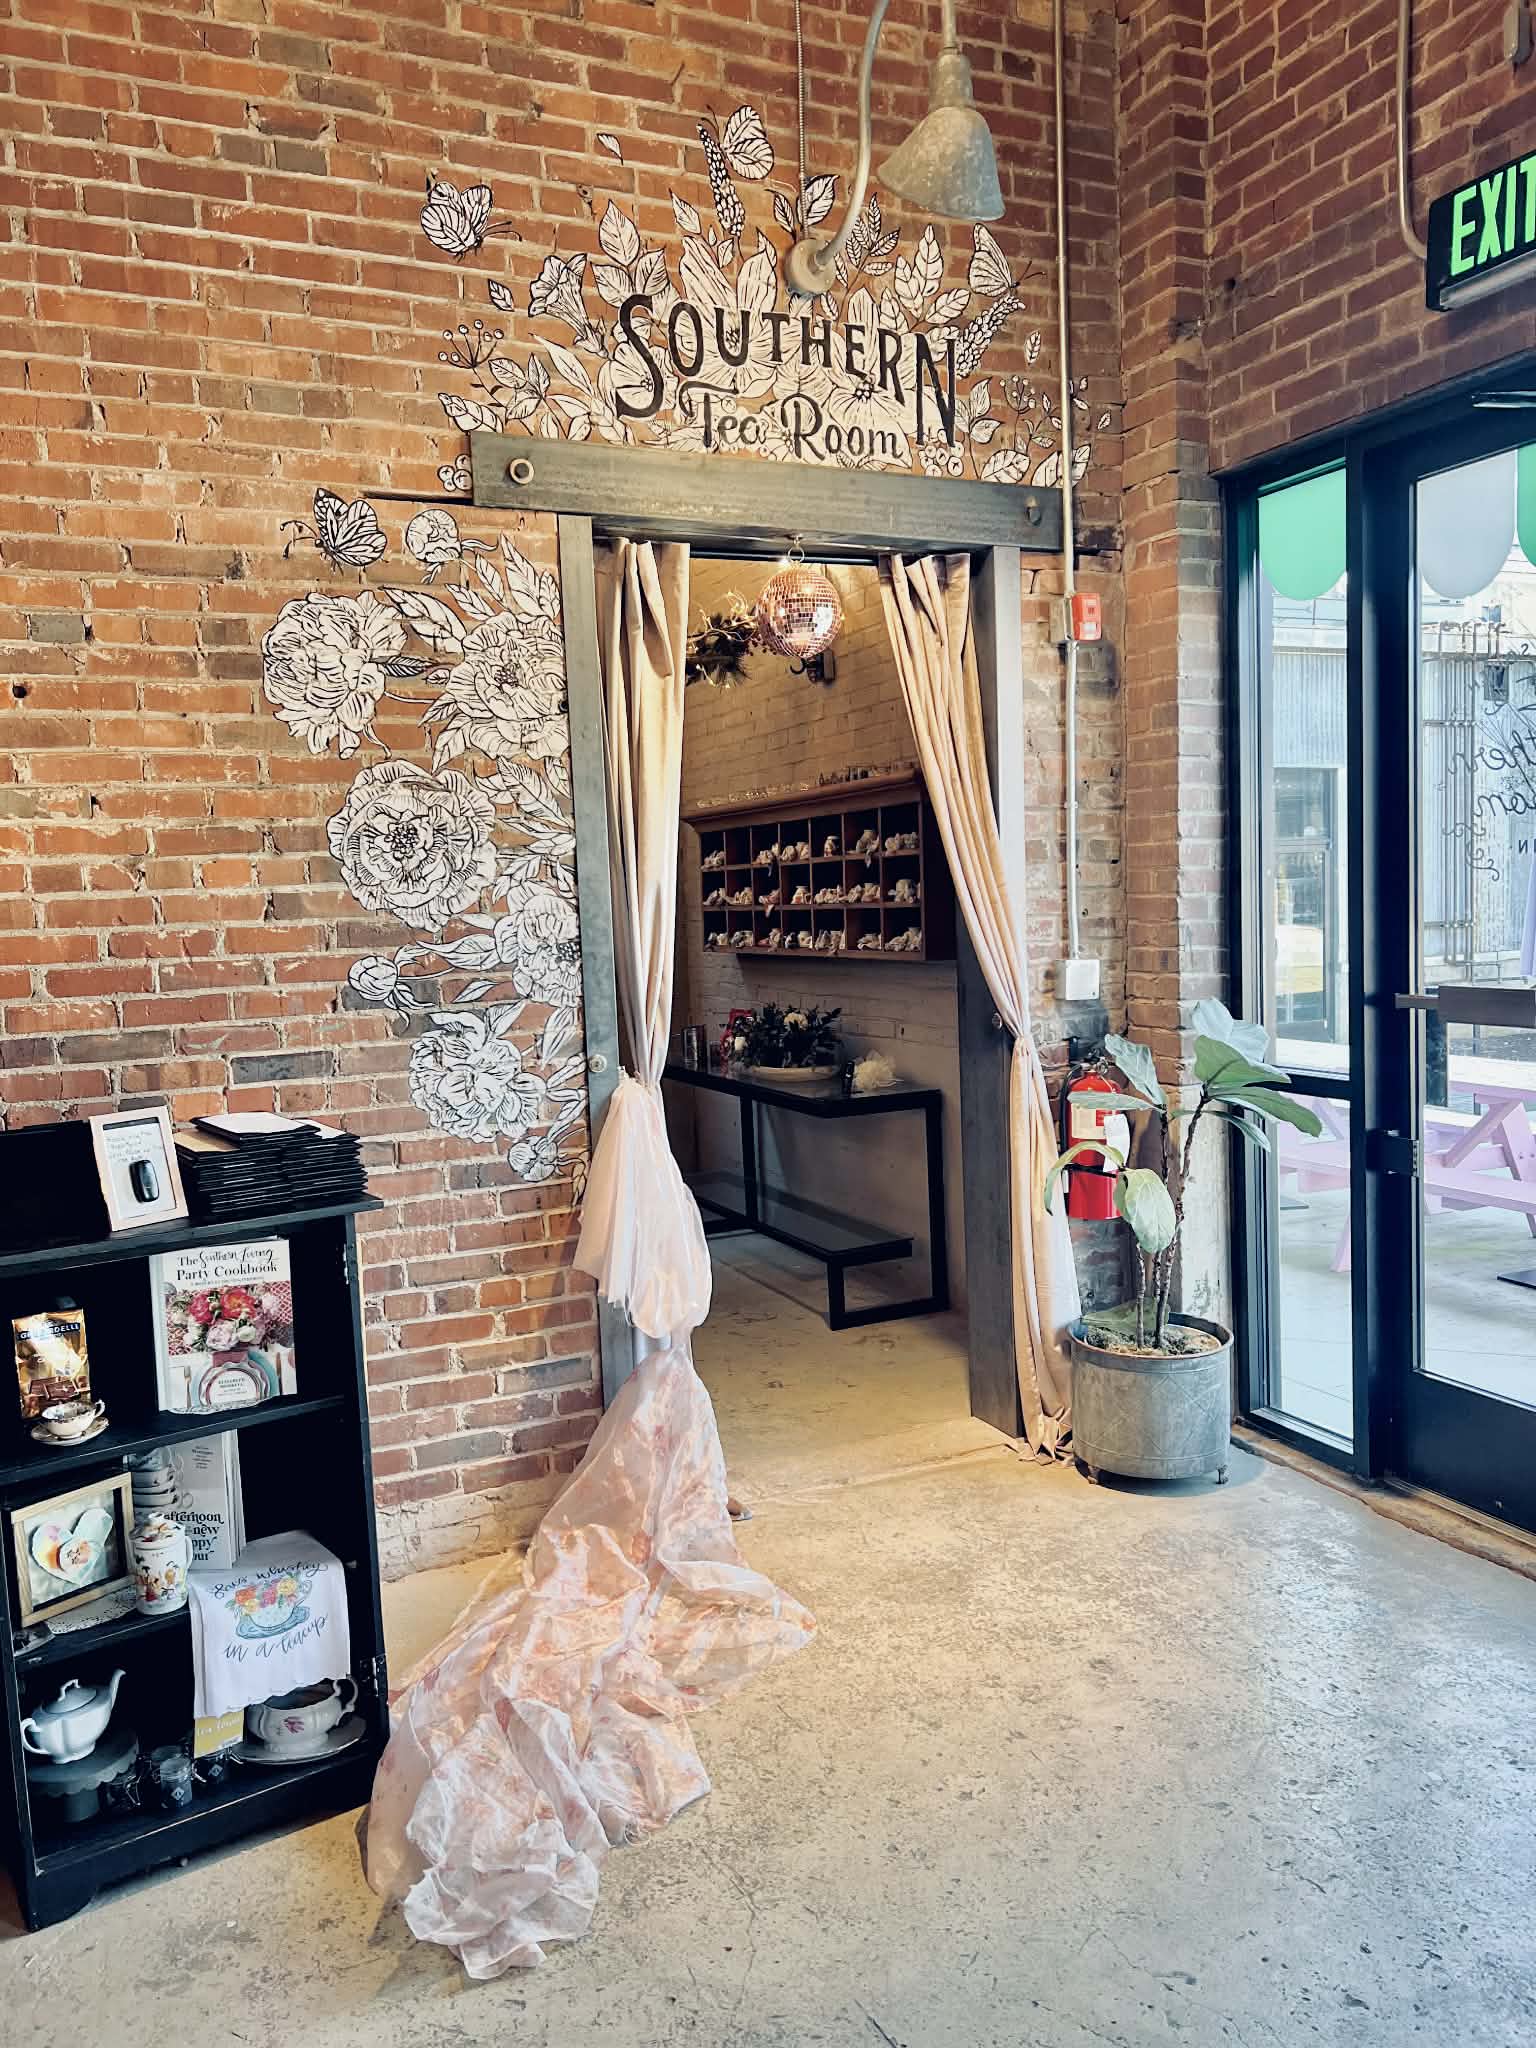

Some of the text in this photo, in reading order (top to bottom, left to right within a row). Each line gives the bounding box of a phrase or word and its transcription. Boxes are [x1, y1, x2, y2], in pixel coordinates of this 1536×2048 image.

[1451, 154, 1536, 277] EXIT
[615, 294, 956, 447] SOUTHERN
[679, 380, 902, 461] Tea Room
[177, 1256, 199, 1267] The
[177, 1261, 278, 1281] Party Cookbook
[163, 1511, 225, 1525] afternoon
[193, 1524, 220, 1537] new
[191, 1536, 217, 1551] ppy
[224, 1612, 329, 1662] in a teacup
